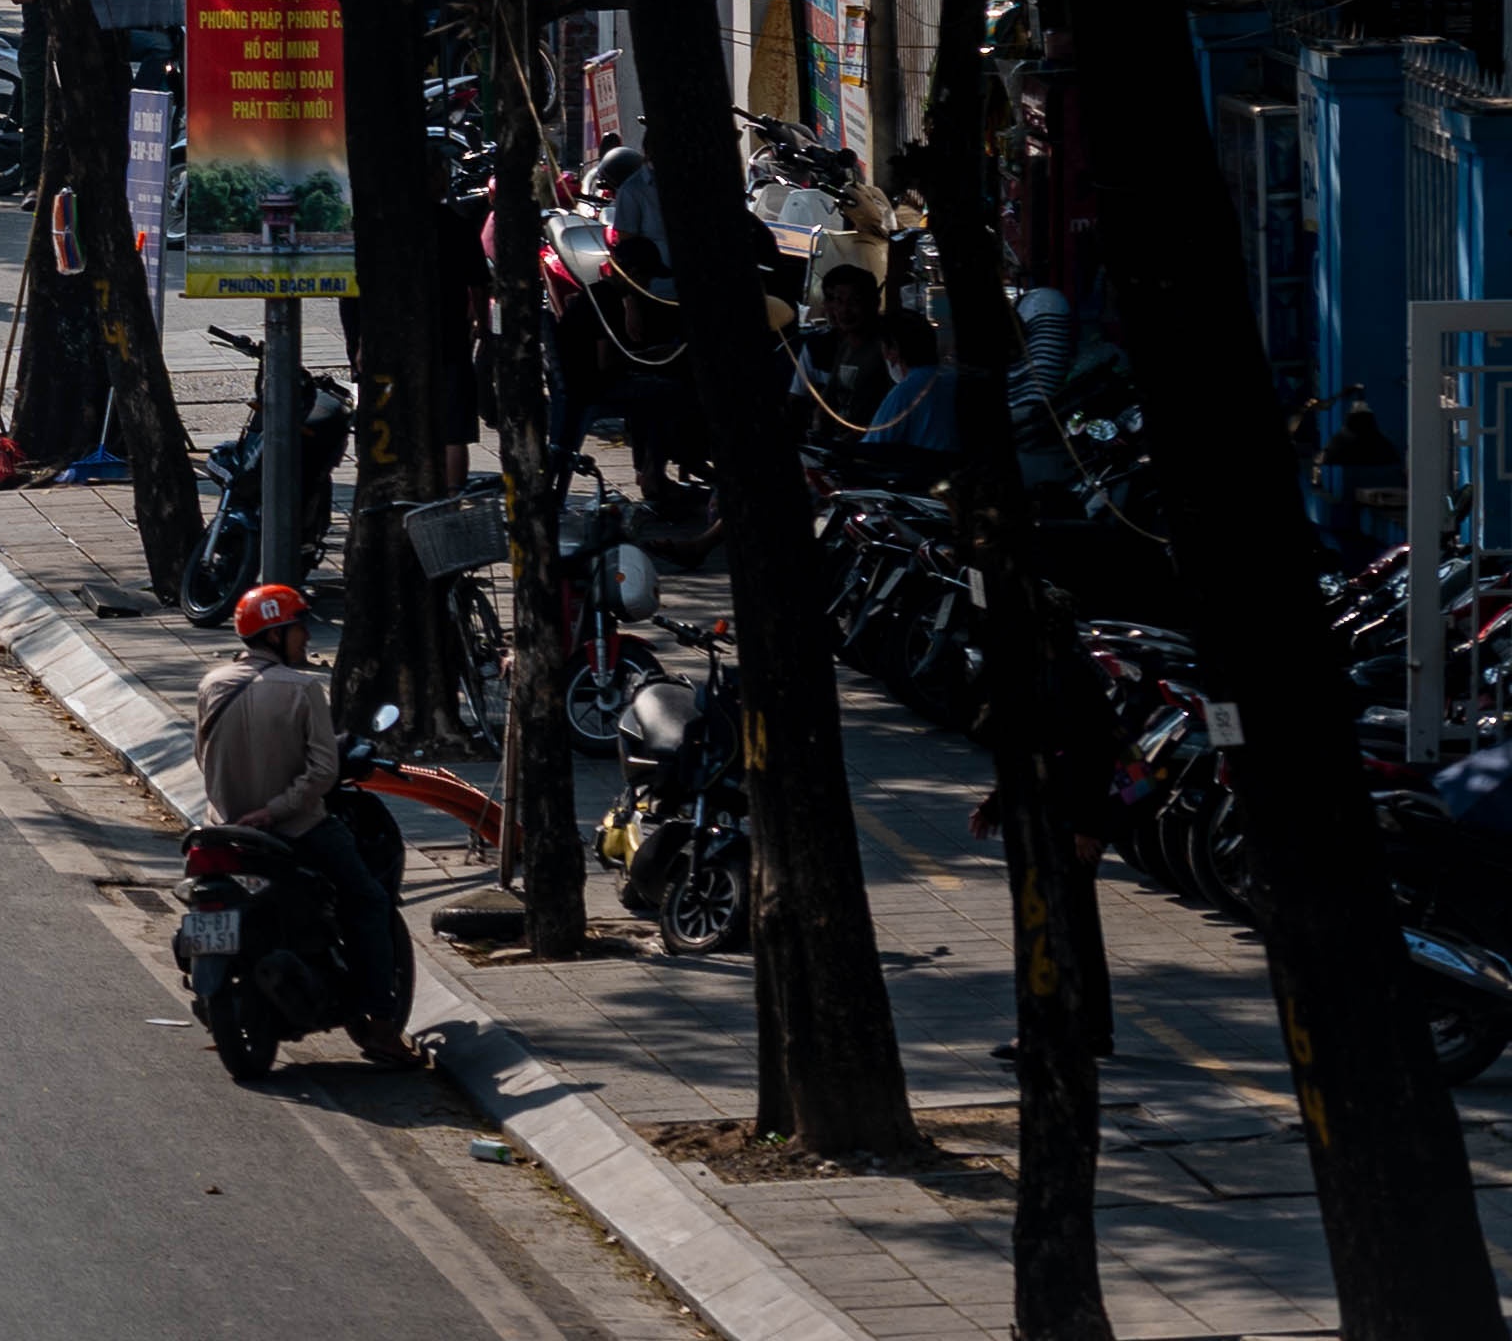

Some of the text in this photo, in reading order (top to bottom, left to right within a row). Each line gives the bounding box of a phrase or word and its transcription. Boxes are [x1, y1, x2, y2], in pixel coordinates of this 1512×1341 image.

[199, 9, 249, 29] PHƯƠNG
[287, 10, 329, 29] PHONG
[264, 36, 283, 59] CHÍ
[287, 40, 319, 59] MINH
[231, 70, 334, 94] TRONG GIAI ĐOẠN
[232, 97, 264, 119] PHÁT
[266, 94, 300, 119] TRIỂN
[218, 275, 347, 296] PHƯỜNG BẠCH MAI
